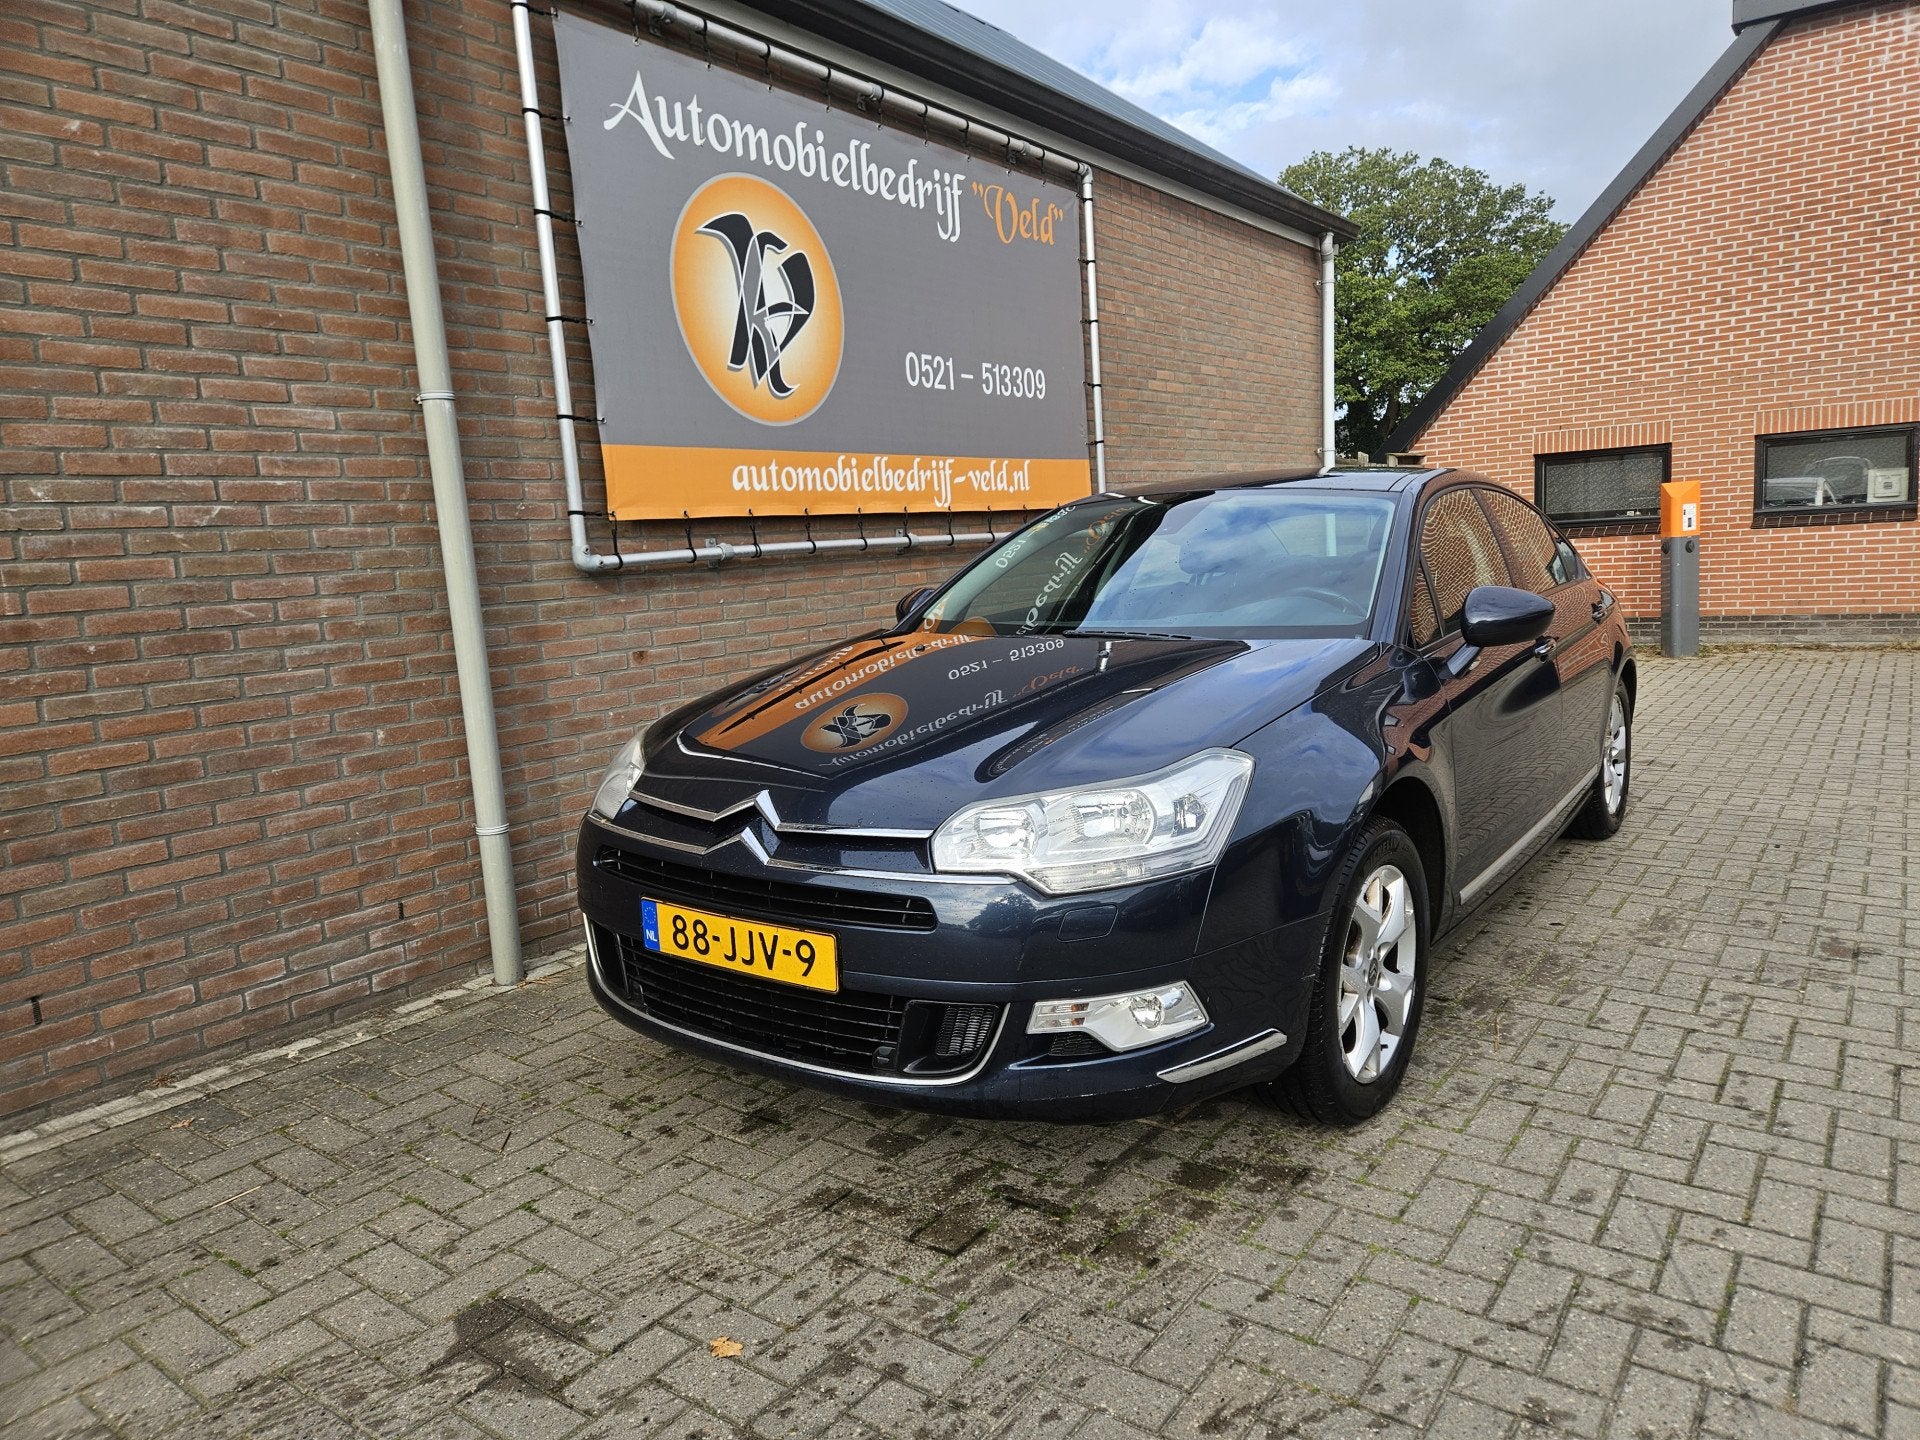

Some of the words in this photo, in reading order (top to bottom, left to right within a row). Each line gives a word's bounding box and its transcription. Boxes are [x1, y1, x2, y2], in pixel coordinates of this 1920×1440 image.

[603, 70, 966, 243] Automobielbedrijf
[905, 351, 955, 391] 0521
[981, 362, 1046, 400] 513309
[731, 454, 1031, 508] automobielbedrijf-veld.nl
[645, 928, 658, 942] NL
[672, 914, 817, 977] 88-JJV-9
